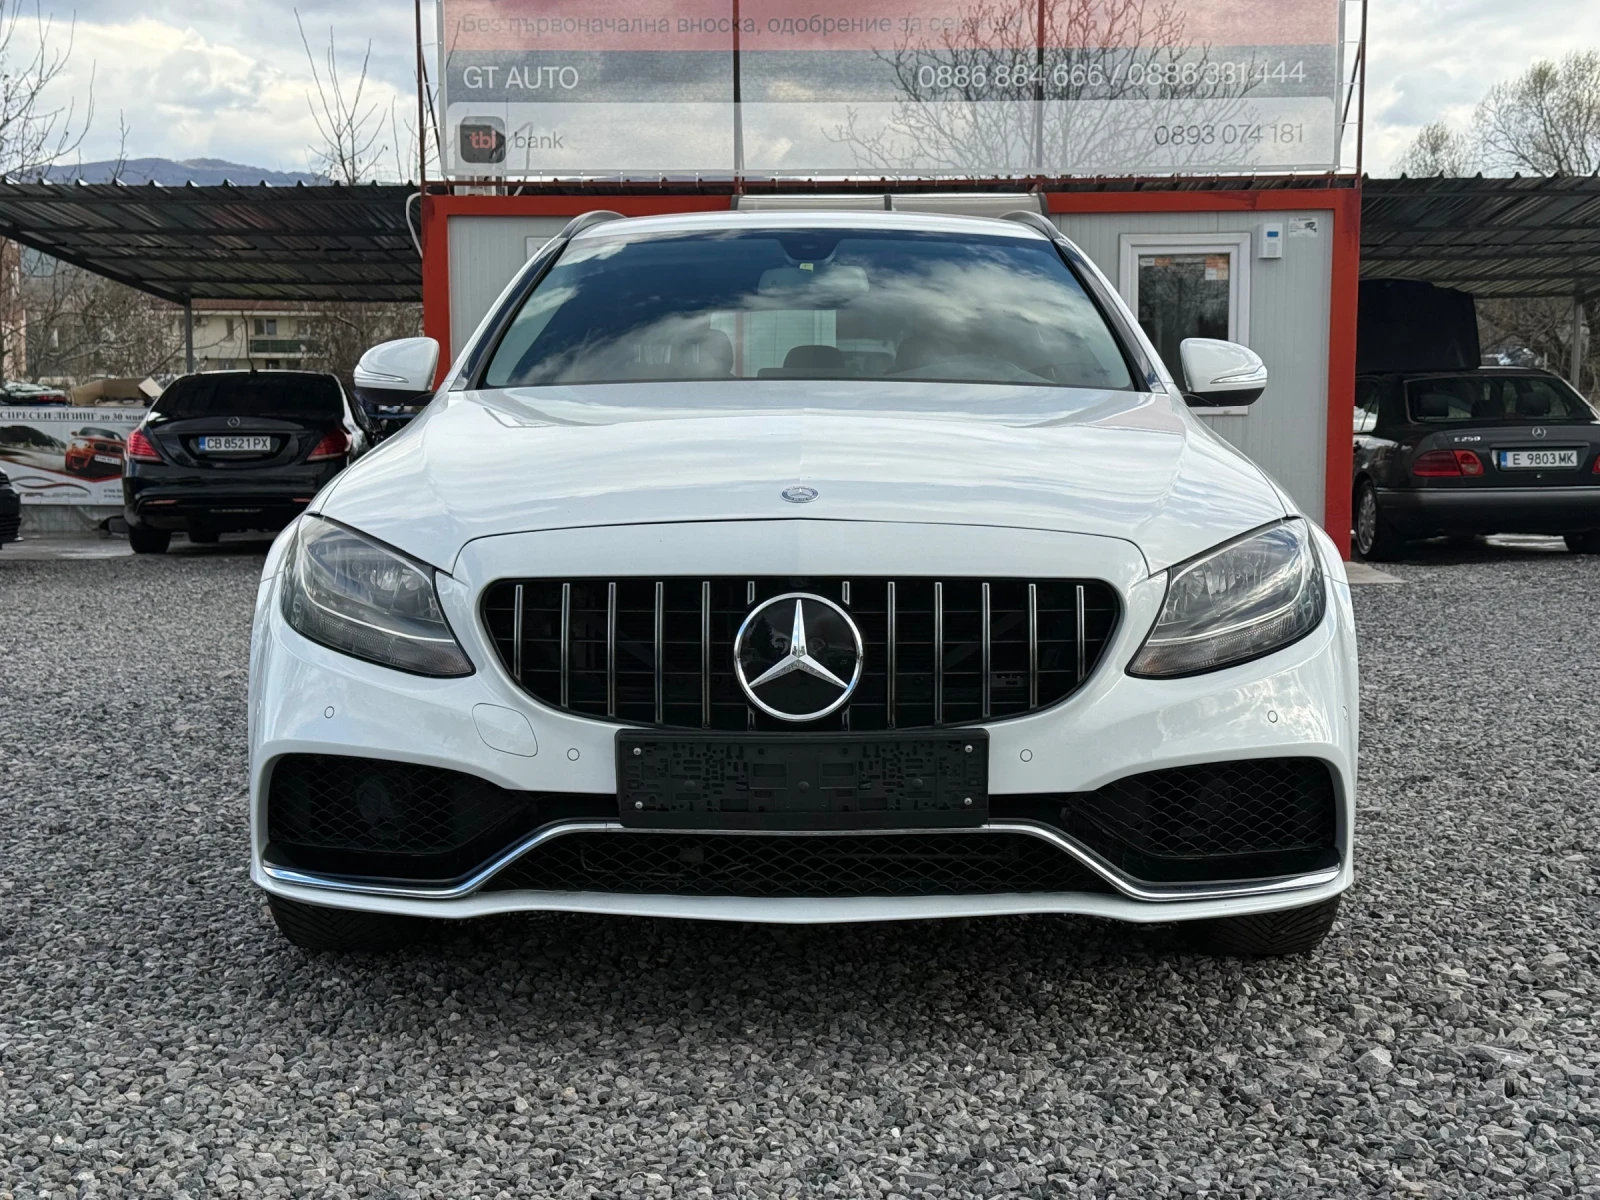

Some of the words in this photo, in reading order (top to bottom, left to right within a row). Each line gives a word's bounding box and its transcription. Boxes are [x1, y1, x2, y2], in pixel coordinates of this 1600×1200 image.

[462, 14, 502, 32] Без
[508, 18, 669, 36] първоначална
[677, 17, 761, 35] вноска,
[767, 14, 892, 36] одобрение
[899, 17, 921, 32] за
[463, 65, 499, 89] GT
[505, 65, 579, 89] AUTO
[918, 65, 987, 88] 0886
[995, 64, 1046, 88] 884
[1053, 63, 1103, 87] 666
[1128, 62, 1197, 86] 0886
[1204, 62, 1246, 85] 331
[1255, 60, 1307, 84] 444
[514, 131, 564, 149] bank
[1154, 124, 1215, 145] 0893
[1222, 123, 1264, 144] 074
[1270, 123, 1303, 143] 181
[54, 411, 98, 420] ЛИЗИНГ
[224, 438, 251, 449] 8521
[1512, 453, 1521, 465] E
[1527, 452, 1556, 465] 9803
[1558, 452, 1575, 465] MK
